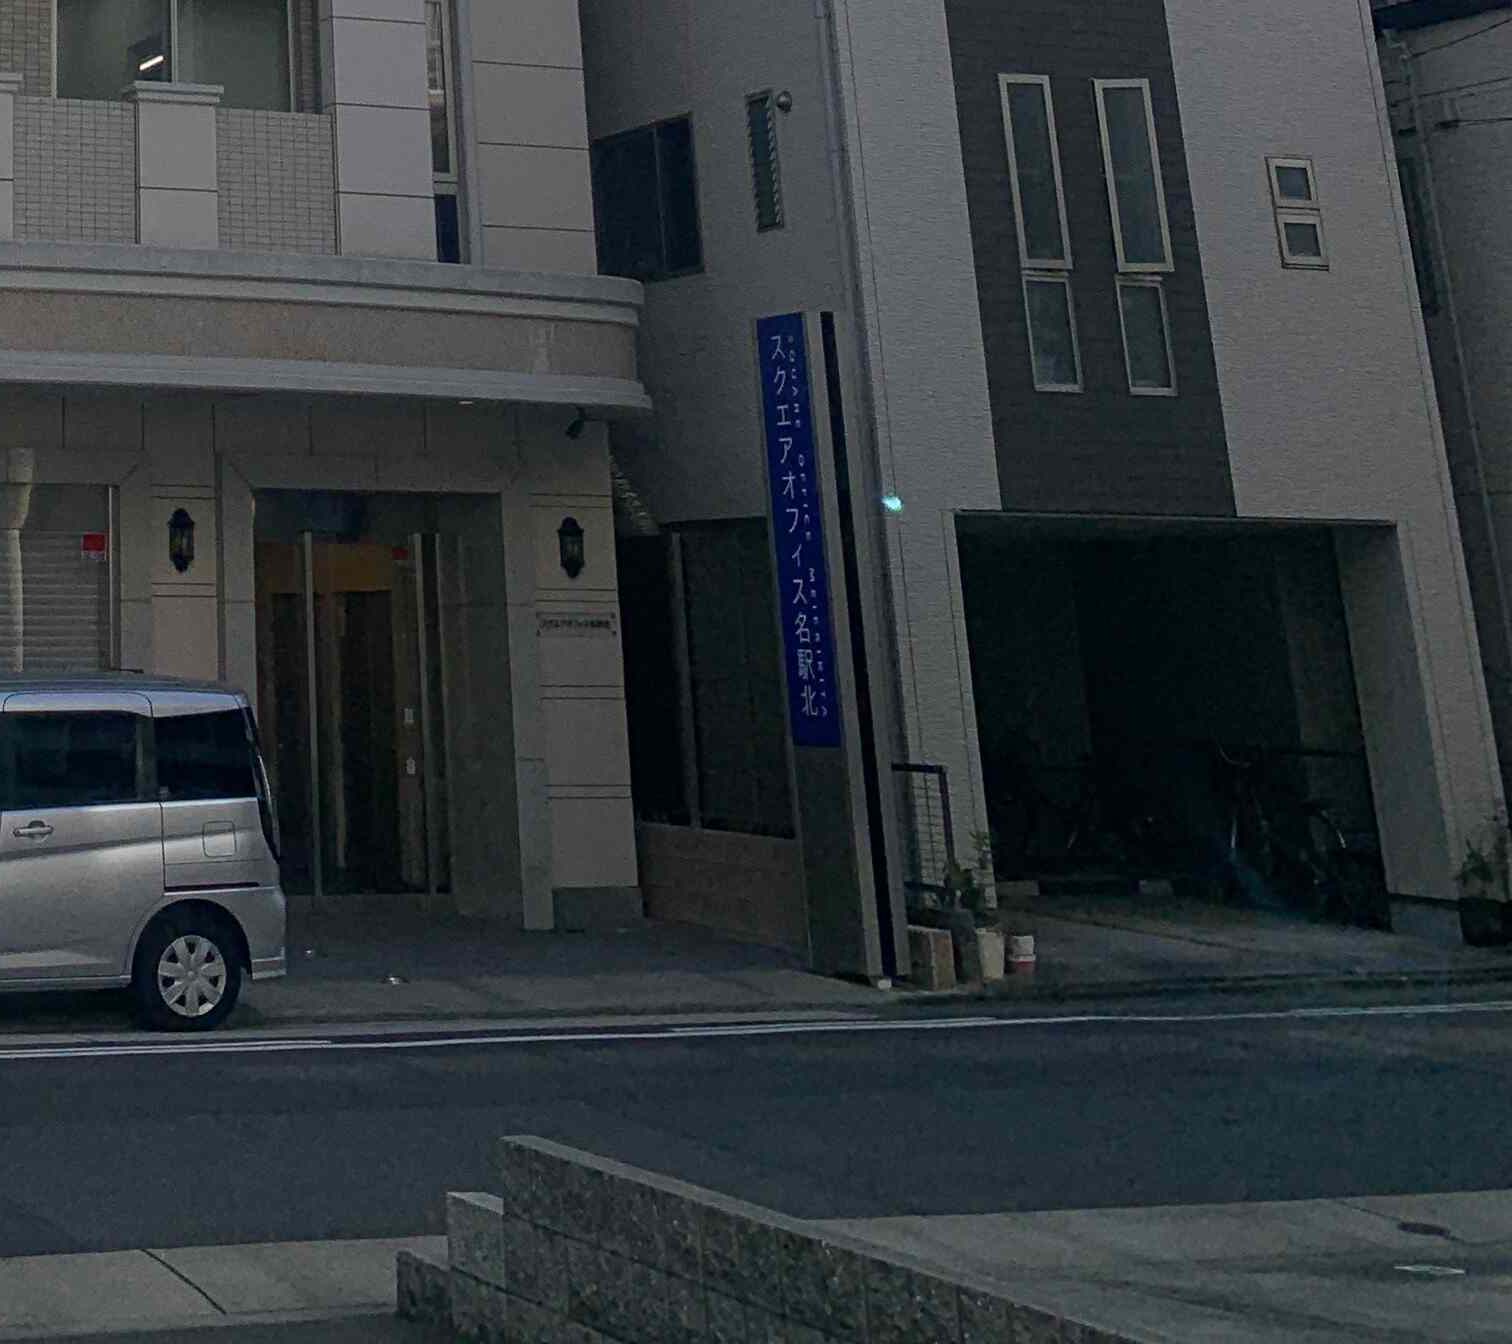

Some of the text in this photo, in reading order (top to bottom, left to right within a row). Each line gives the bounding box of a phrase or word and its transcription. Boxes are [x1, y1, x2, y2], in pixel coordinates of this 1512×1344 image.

[770, 335, 818, 717] スクエアオフィス名駅北
